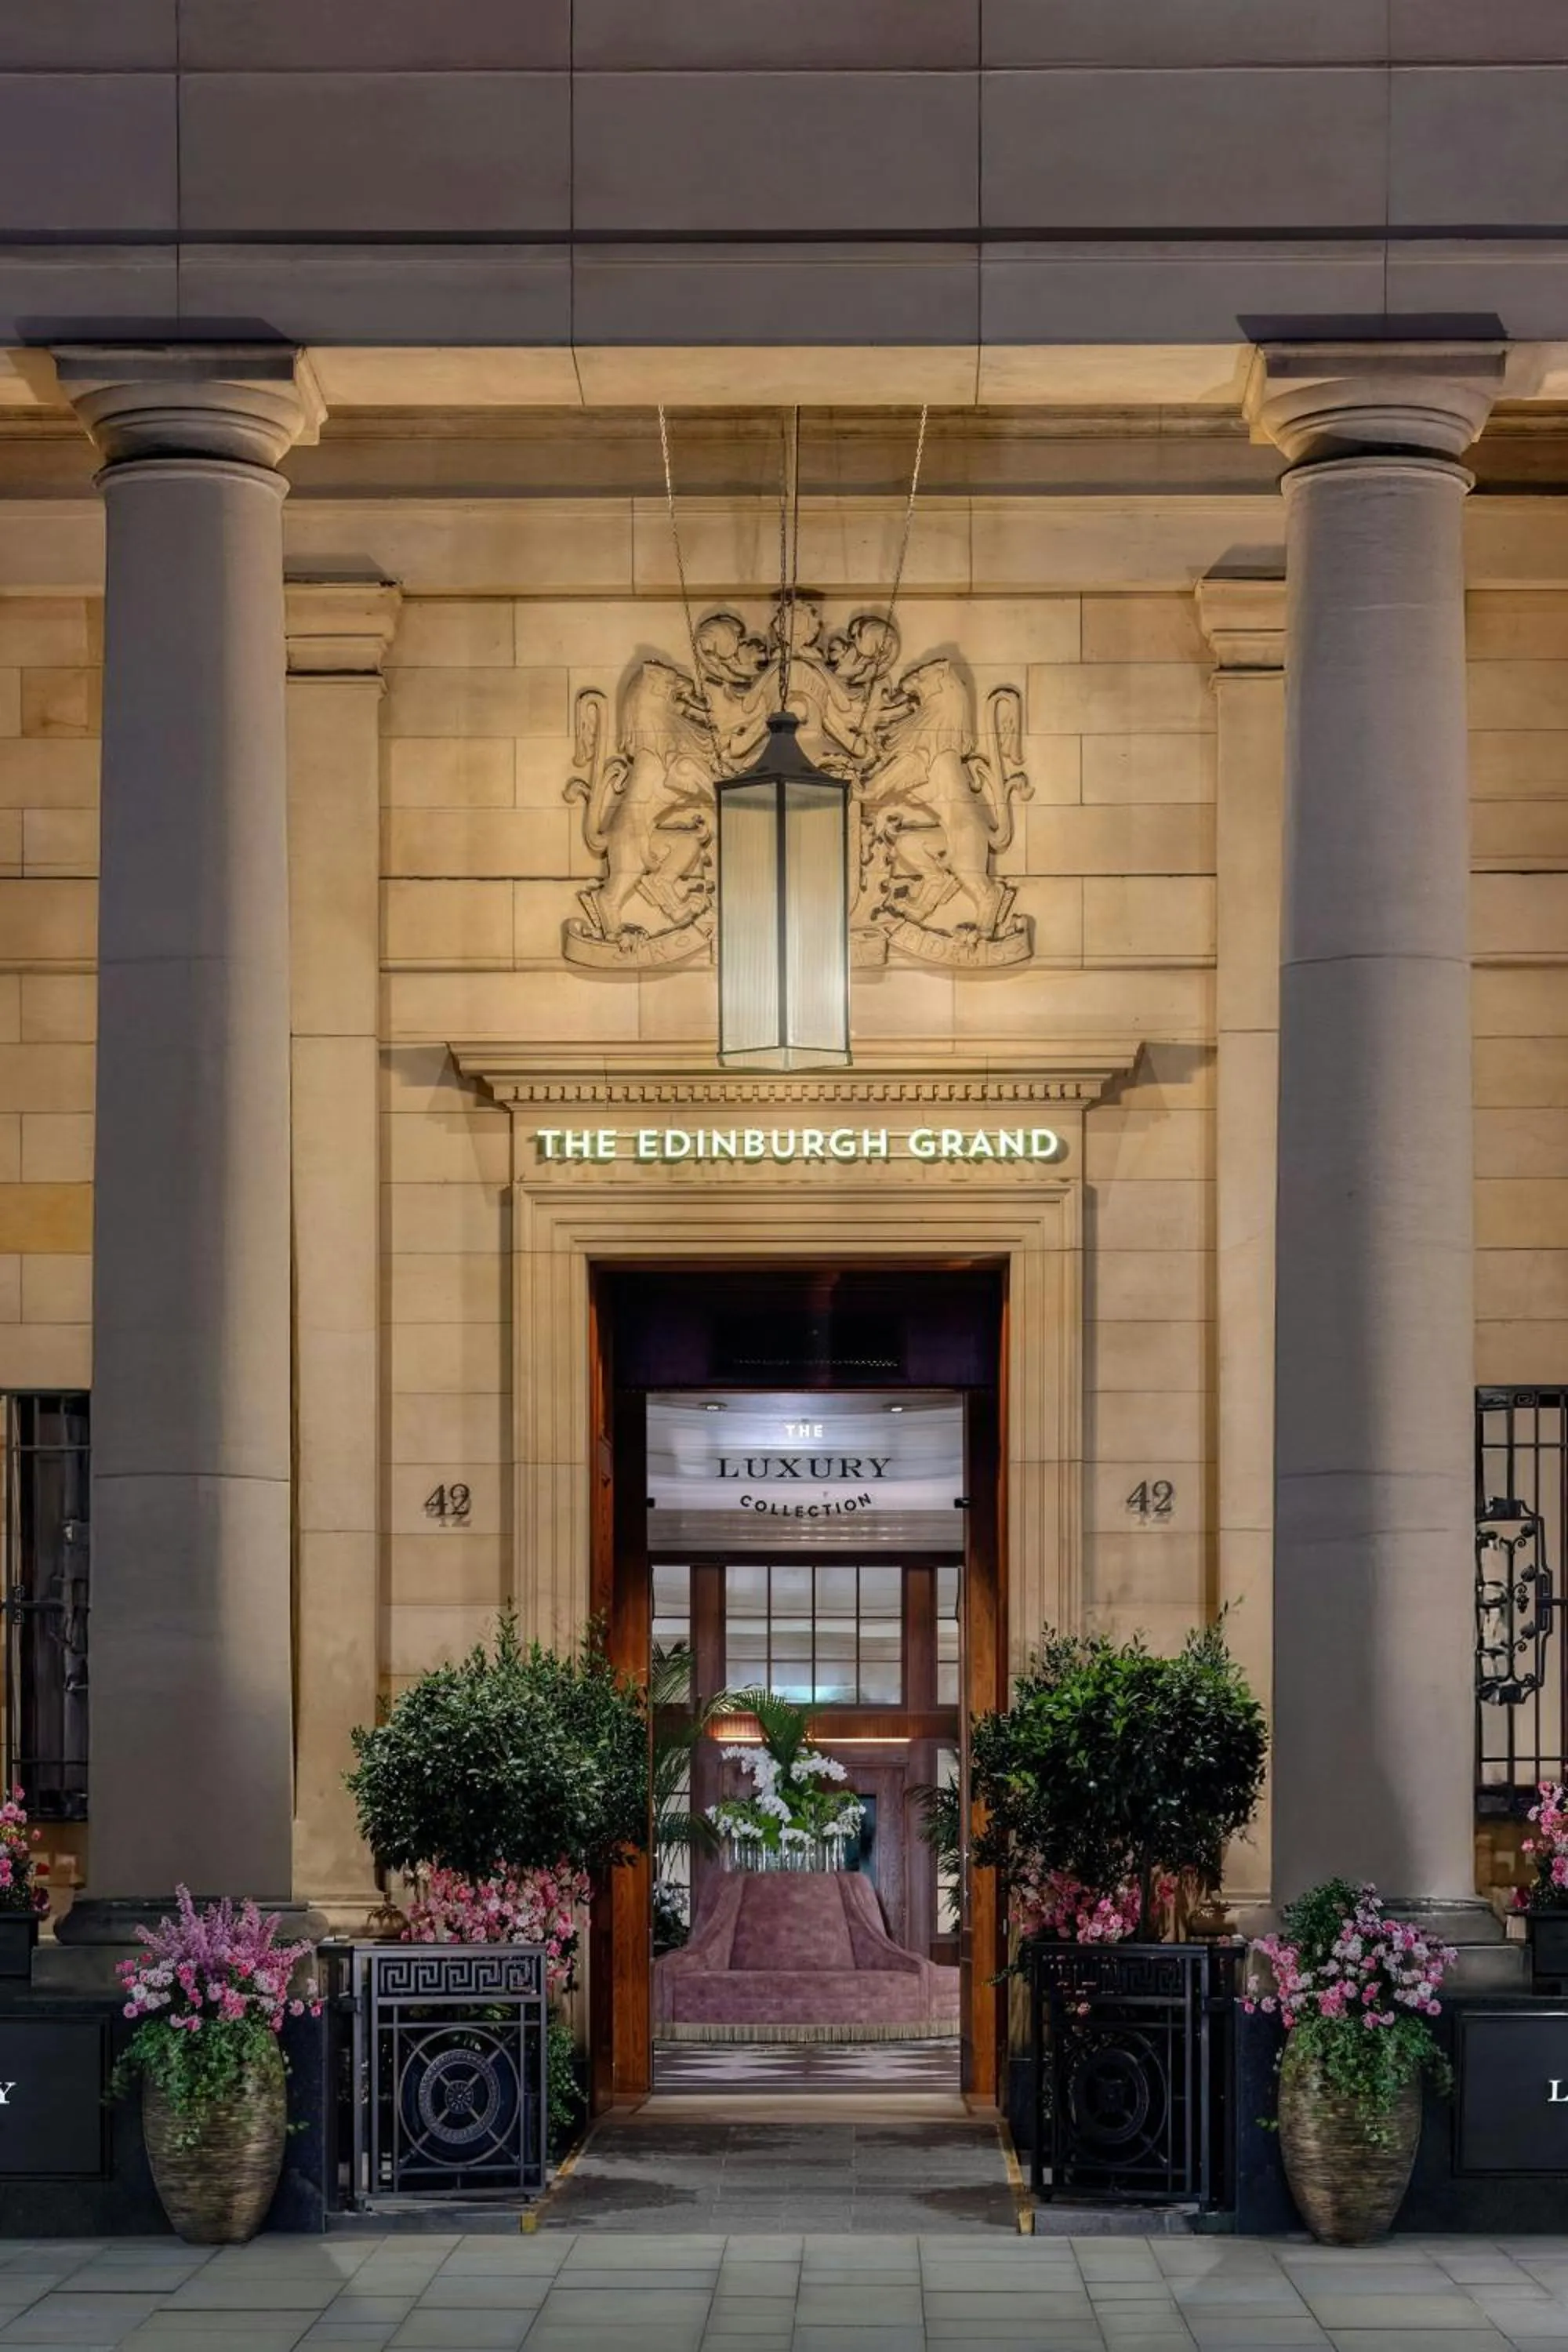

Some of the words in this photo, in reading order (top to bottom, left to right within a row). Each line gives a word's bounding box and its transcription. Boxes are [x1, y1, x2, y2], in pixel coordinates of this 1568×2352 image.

[537, 1129, 617, 1159] THE
[638, 1128, 888, 1159] EDINBURGH
[909, 1128, 1059, 1158] GRAND
[785, 1424, 824, 1438] THE
[716, 1457, 892, 1479] LUXURY
[423, 1483, 470, 1516] 42
[740, 1493, 872, 1518] COLLECTION
[1126, 1479, 1174, 1512] 42
